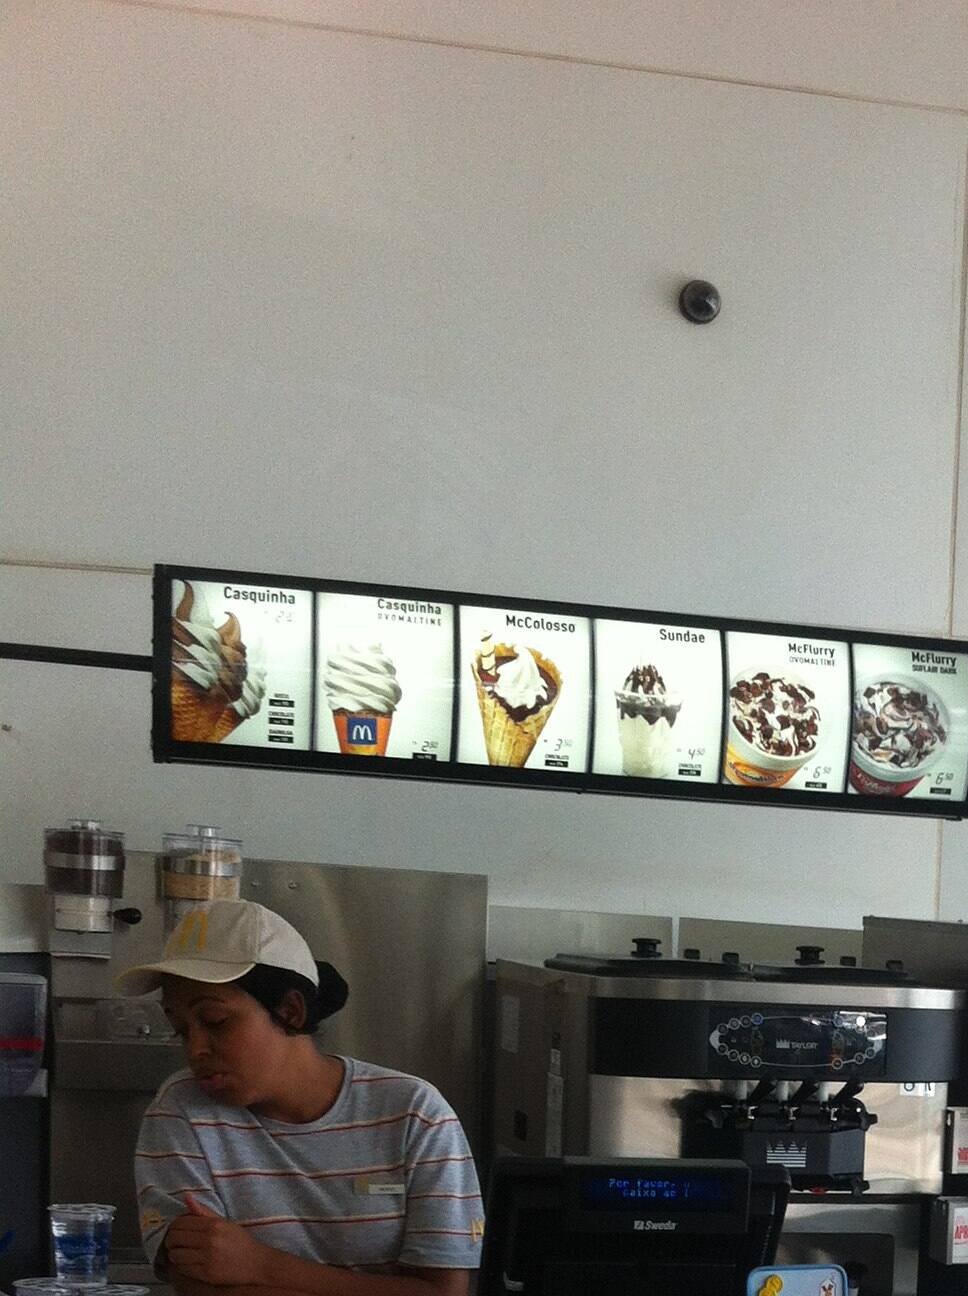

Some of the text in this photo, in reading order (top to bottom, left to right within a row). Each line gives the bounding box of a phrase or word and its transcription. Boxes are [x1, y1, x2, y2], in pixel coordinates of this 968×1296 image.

[223, 586, 296, 605] Casquinha
[377, 598, 441, 615] Casquinha
[377, 613, 441, 626] OVOMALTINE
[505, 614, 576, 633] McColosso
[659, 628, 706, 644] Sundae
[788, 643, 835, 659] McFlurry
[789, 656, 835, 667] OVOMALTINE
[911, 651, 957, 668] McFlurry
[645, 1220, 677, 1231] Sweda
